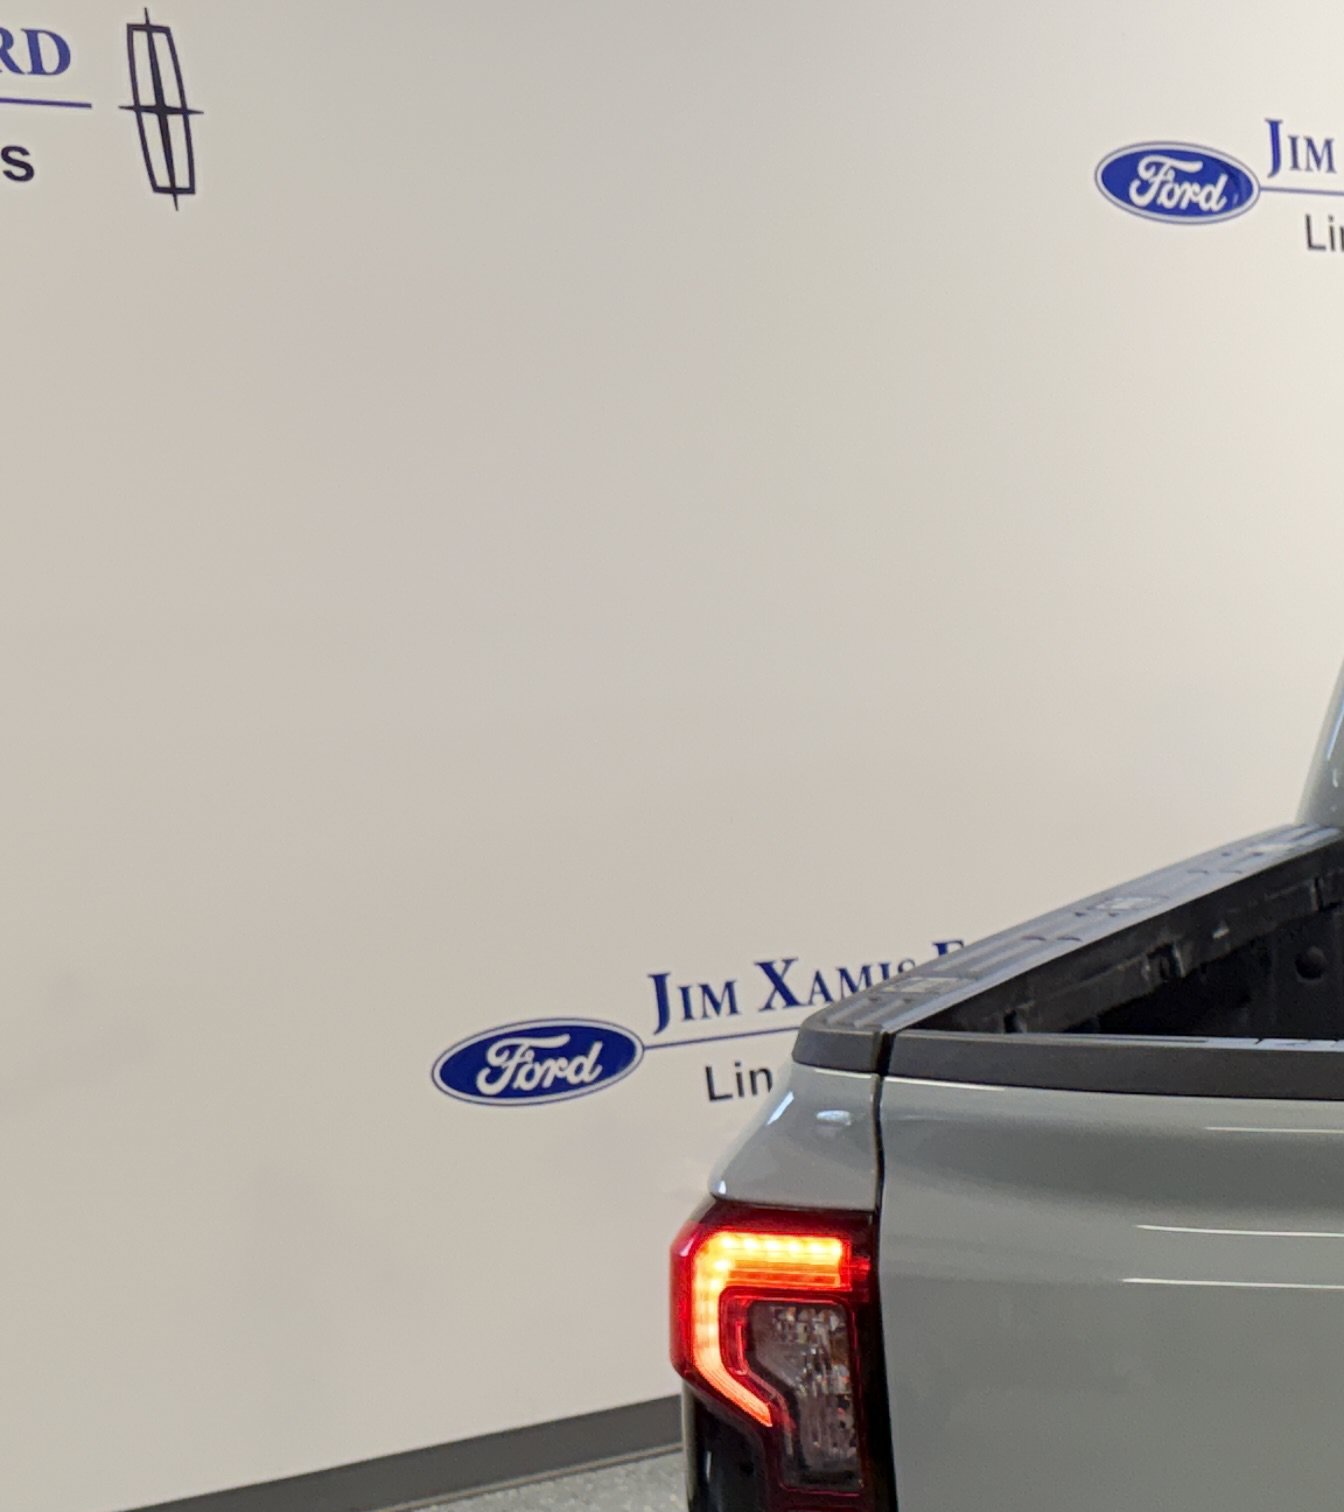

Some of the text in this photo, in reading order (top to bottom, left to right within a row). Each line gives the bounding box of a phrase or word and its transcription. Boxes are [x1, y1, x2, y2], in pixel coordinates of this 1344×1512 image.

[1264, 118, 1337, 178] JIM
[1129, 154, 1227, 213] Ford
[647, 972, 740, 1035] JIM
[476, 1033, 604, 1096] Ford
